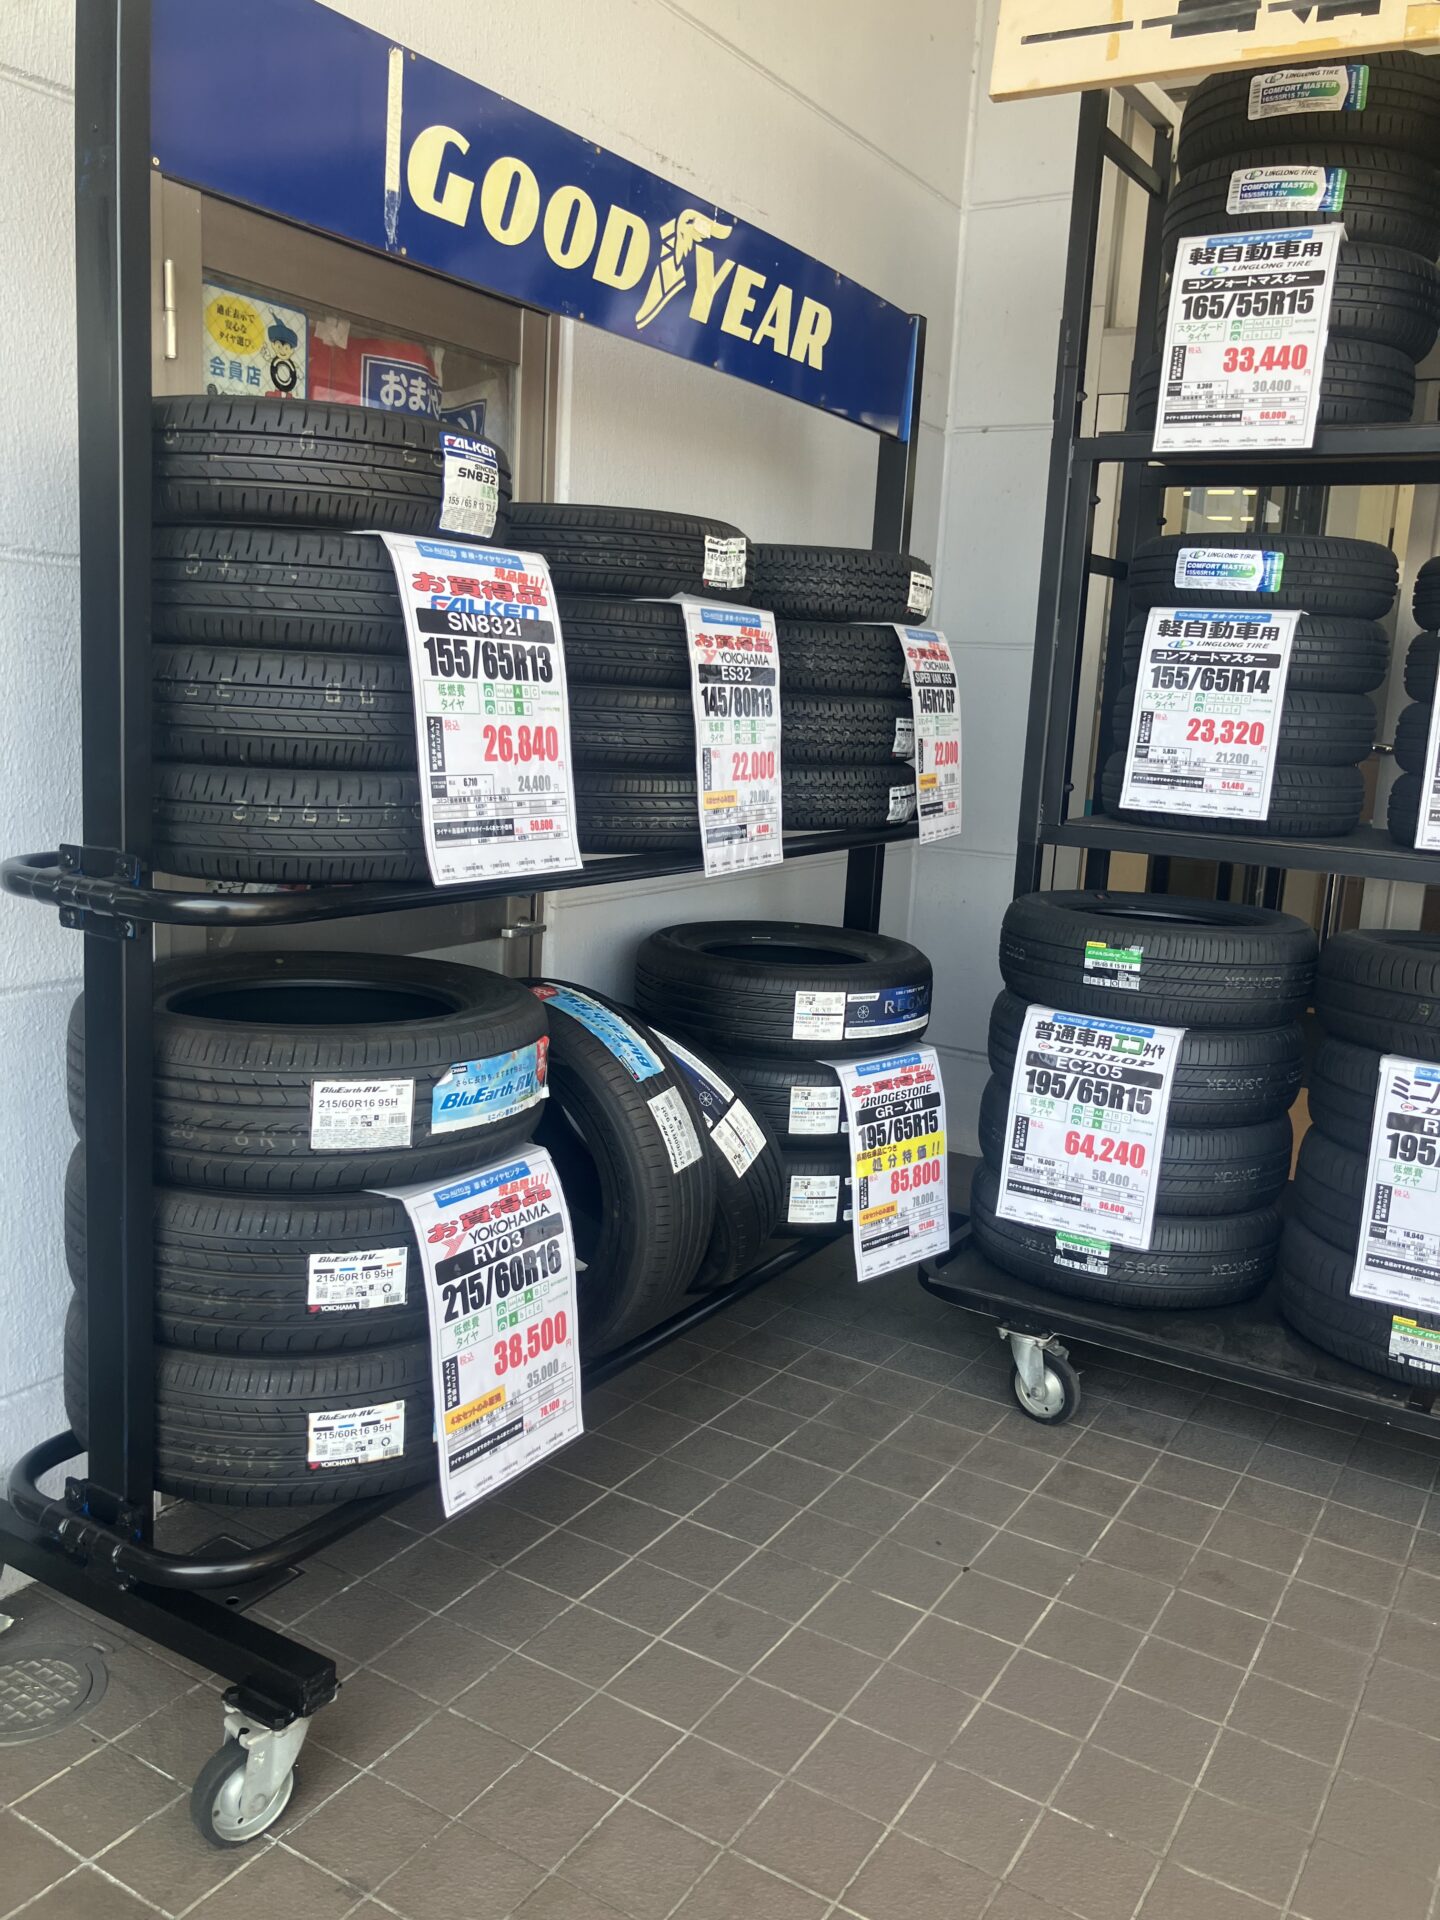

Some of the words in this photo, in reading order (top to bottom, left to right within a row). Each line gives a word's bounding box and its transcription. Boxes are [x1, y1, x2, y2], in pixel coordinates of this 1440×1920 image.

[1263, 83, 1300, 95] COMFORT
[1303, 81, 1337, 90] MASTER
[1242, 182, 1279, 191] COMFORT
[1281, 181, 1315, 190] MASTER
[407, 125, 833, 371] GOODYEAR
[1189, 240, 1323, 266] 軽自動車用
[1232, 262, 1284, 272] LINGLONG
[1187, 274, 1310, 290] コンフォートマスター
[1182, 288, 1315, 320] 165/55R15
[1177, 322, 1223, 333] スタンダード
[1187, 332, 1210, 342] タイヤ
[1223, 344, 1308, 374] 33,440
[209, 356, 262, 388] 会員店
[1252, 379, 1292, 393] 30,400
[444, 434, 496, 459] FALKEN
[1221, 563, 1253, 571] MASTER
[411, 571, 548, 607] お買得品
[430, 594, 539, 621] FALKEN
[447, 612, 523, 637] SN832i
[1157, 619, 1281, 641] 軽自動車用
[694, 633, 773, 654] お買得品
[423, 636, 553, 683] 155/65R13
[718, 651, 770, 666] YOKOHAMA
[1156, 651, 1268, 664] コンフォートマスター
[721, 666, 752, 682] ES32
[915, 672, 931, 684] SUPER
[1150, 665, 1271, 694] 155/65R14
[438, 683, 466, 698] 低燃費
[917, 688, 946, 714] 145R12
[1146, 691, 1188, 700] スタンダード
[441, 699, 465, 711] タイヤ
[701, 686, 773, 718] 145/80R13
[1185, 717, 1265, 746] 23,320
[482, 724, 559, 765] 26,840
[934, 741, 959, 767] 22,000
[732, 750, 775, 782] 22,000
[1215, 751, 1250, 765] 21,200
[517, 775, 551, 793] 24,400
[1034, 1020, 1165, 1060] 普通車用エコタイヤ
[1056, 1045, 1156, 1067] DUNLOP
[1055, 1056, 1123, 1079] EC205
[439, 1070, 535, 1110] BluEarth-RV
[851, 1070, 935, 1098] お買得品
[1025, 1068, 1153, 1115] 195/65R15
[318, 1099, 375, 1108] 215/60R16
[377, 1098, 398, 1107] 95H
[860, 1083, 932, 1109] BRIDGESTONE
[1029, 1098, 1056, 1110] 低燃費
[1030, 1106, 1054, 1118] タイヤ
[858, 1109, 939, 1152] 195/65R15
[1064, 1130, 1147, 1169] 64,240
[890, 1159, 941, 1195] 85,800
[1091, 1168, 1130, 1187] 58,400
[1393, 1163, 1423, 1178] 低燃費
[1394, 1175, 1420, 1187] タイヤ
[911, 1191, 934, 1208] 78,000
[427, 1183, 552, 1244] お買得品
[468, 1202, 551, 1245] YOKOHAMA
[472, 1232, 524, 1266] RV03
[316, 1271, 372, 1283] 215/60R16
[374, 1268, 394, 1279] 95H
[442, 1239, 562, 1324] 215/60R16
[320, 1303, 357, 1312] YOKOHAMA
[453, 1315, 480, 1337] 低燃費
[455, 1330, 479, 1349] タイヤ
[493, 1310, 567, 1376] 38,500
[526, 1358, 560, 1389] 35,000
[316, 1427, 370, 1441] 215/60R16
[372, 1423, 392, 1434] 95H
[320, 1458, 356, 1468] YOKOHAMA
